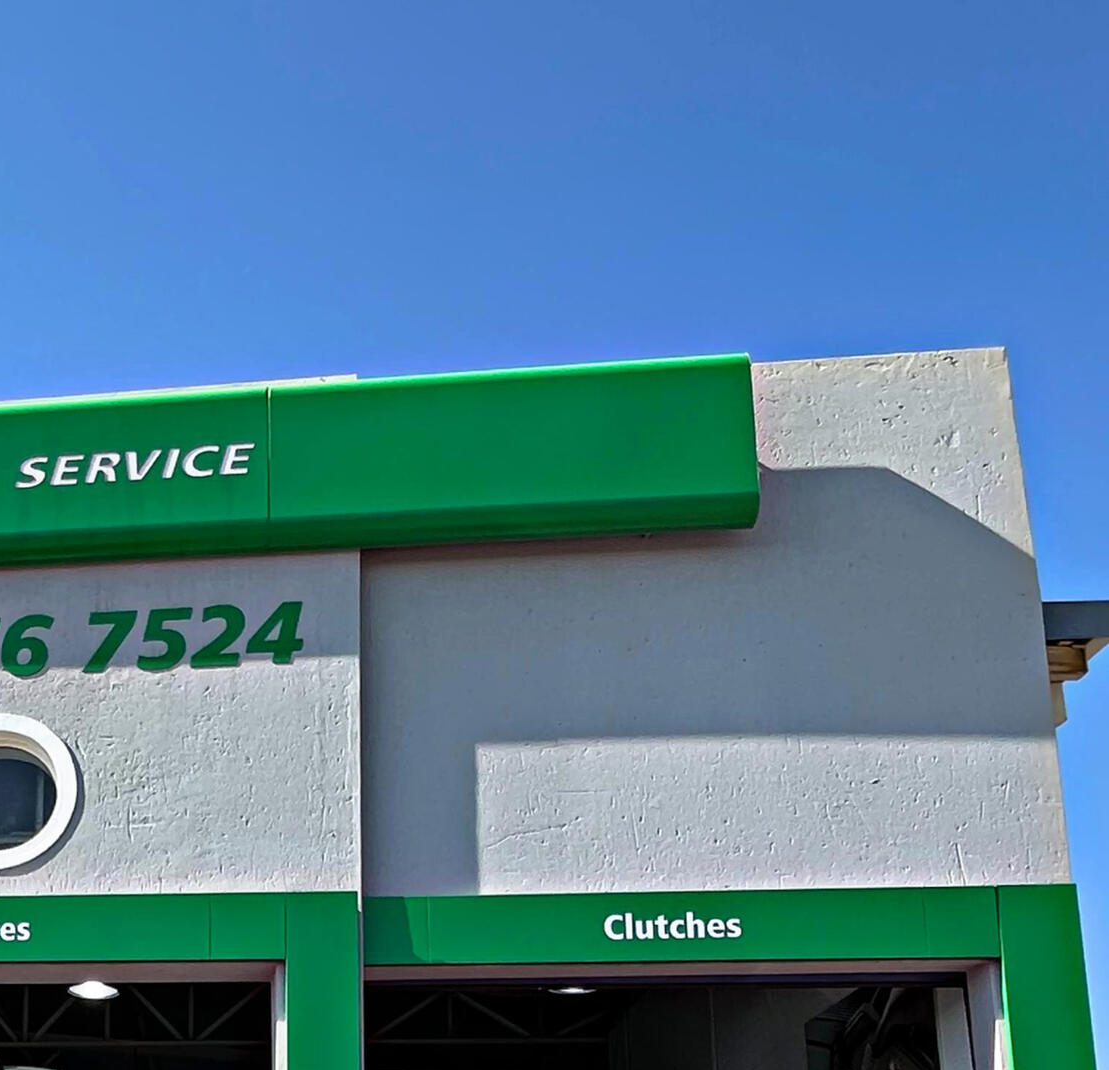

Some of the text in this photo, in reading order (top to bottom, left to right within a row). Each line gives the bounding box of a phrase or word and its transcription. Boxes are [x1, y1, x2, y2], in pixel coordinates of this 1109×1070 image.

[15, 443, 256, 488] SERVICE
[82, 601, 303, 673] 7524
[603, 911, 742, 940] Clutches
